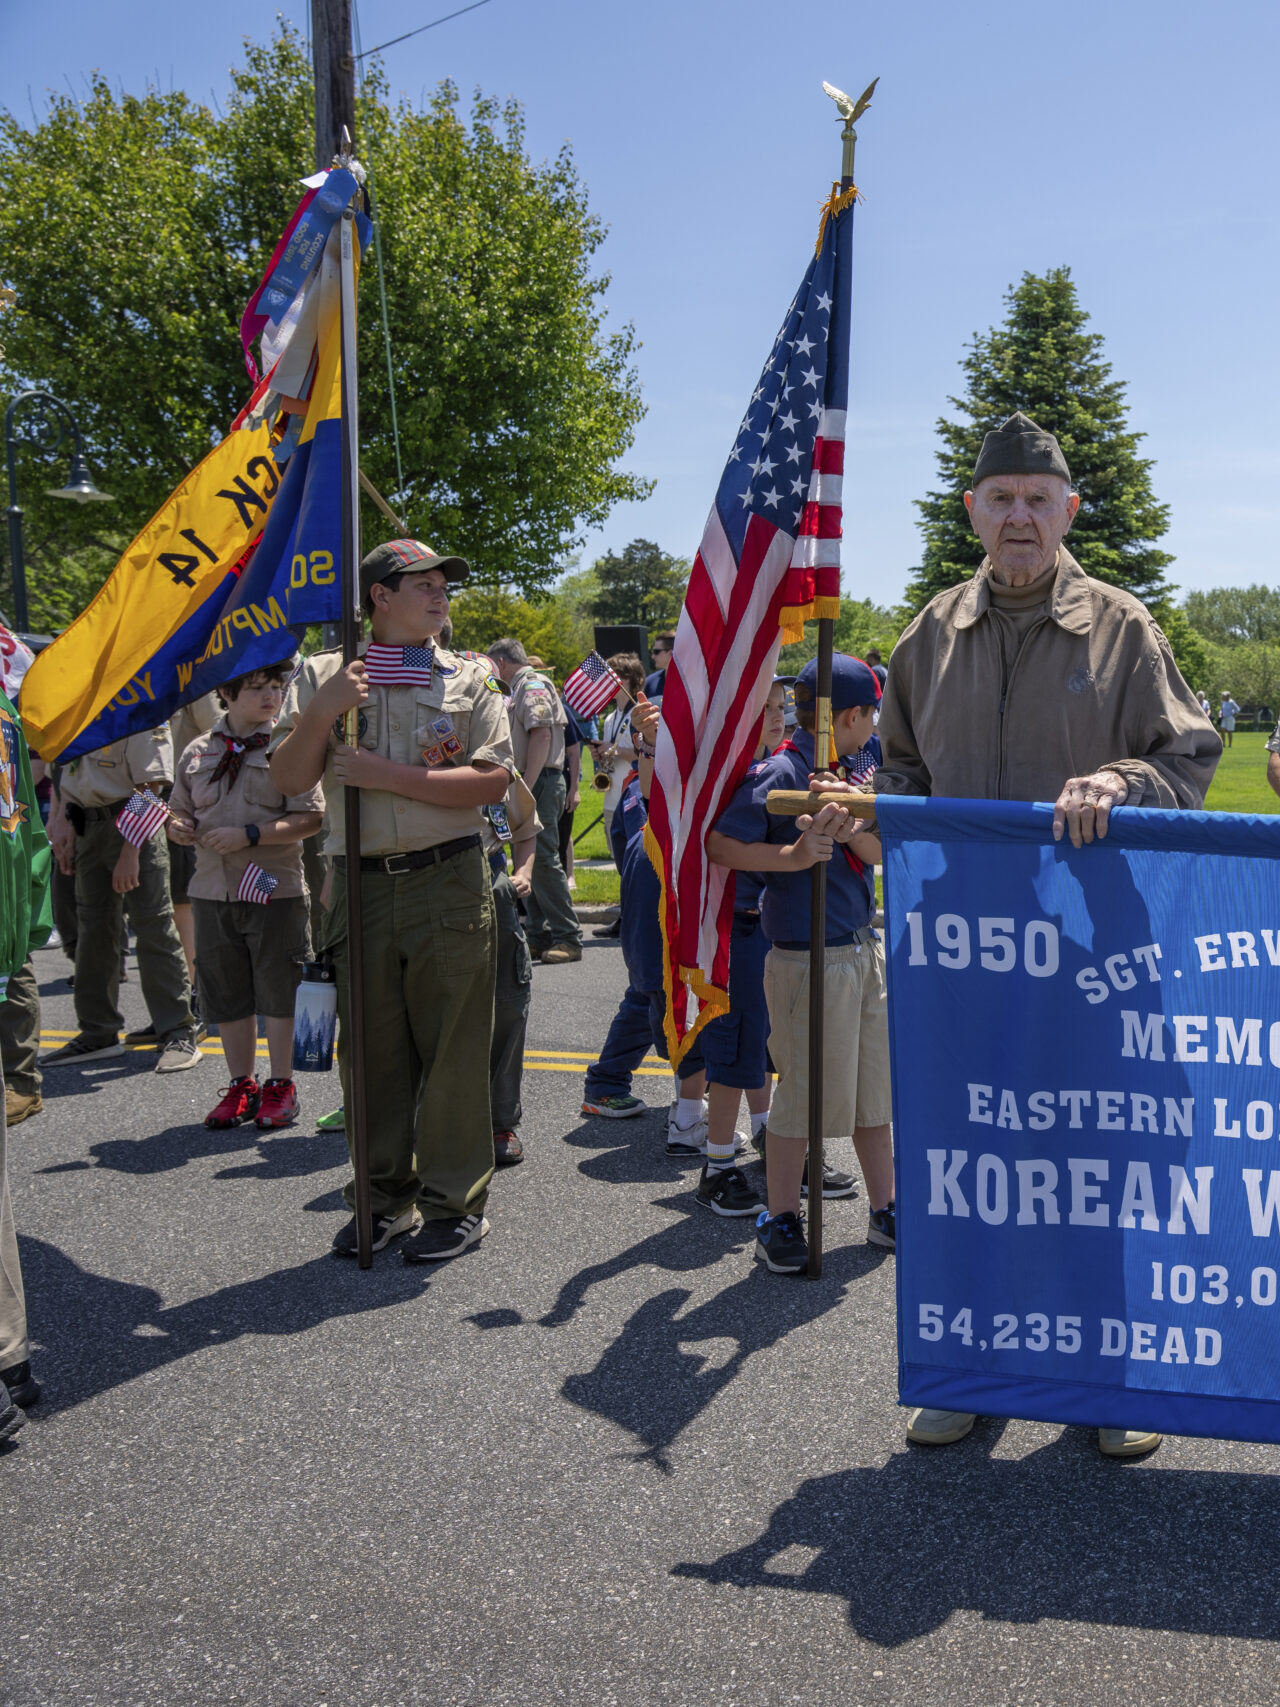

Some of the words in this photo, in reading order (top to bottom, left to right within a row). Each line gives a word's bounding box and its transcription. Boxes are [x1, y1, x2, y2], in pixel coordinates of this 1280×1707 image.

[905, 911, 1060, 977] 1950
[1076, 943, 1183, 1004] SGT.
[967, 1083, 1195, 1139] EASTERN
[927, 1149, 1214, 1235] KOREAN
[918, 1303, 1081, 1357] 54,235
[1100, 1318, 1222, 1366] DEAD
